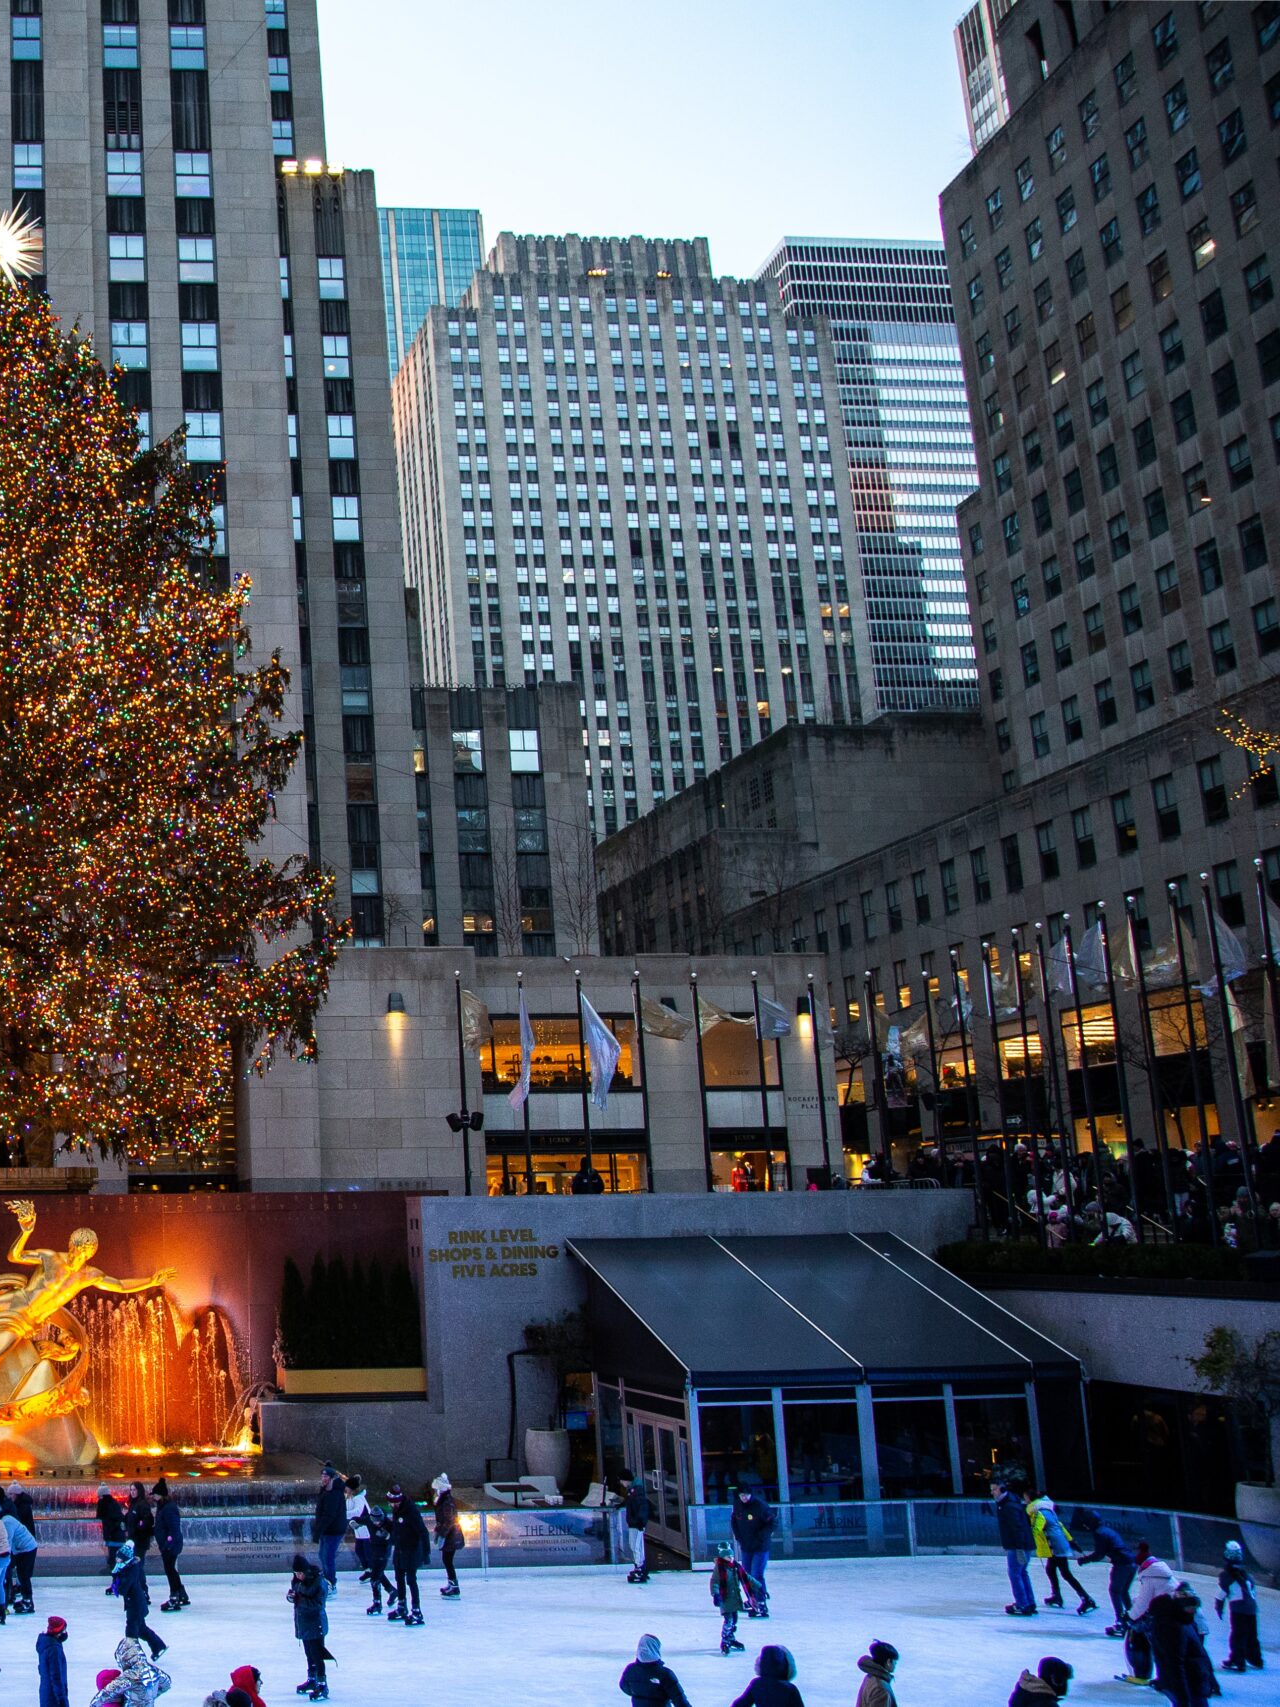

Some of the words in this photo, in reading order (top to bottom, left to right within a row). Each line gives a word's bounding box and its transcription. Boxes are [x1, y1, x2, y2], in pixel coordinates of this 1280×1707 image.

[448, 1230, 488, 1244] RINK
[491, 1229, 537, 1242] LEVEL
[429, 1248, 482, 1262] SHOPS
[486, 1247, 497, 1260] &
[501, 1245, 559, 1259] DINING
[452, 1264, 486, 1278] FIVE
[490, 1263, 537, 1277] ACRES
[227, 1532, 247, 1543] THE
[251, 1531, 277, 1543] RINK
[524, 1525, 544, 1536] THE
[548, 1524, 573, 1536] RINK
